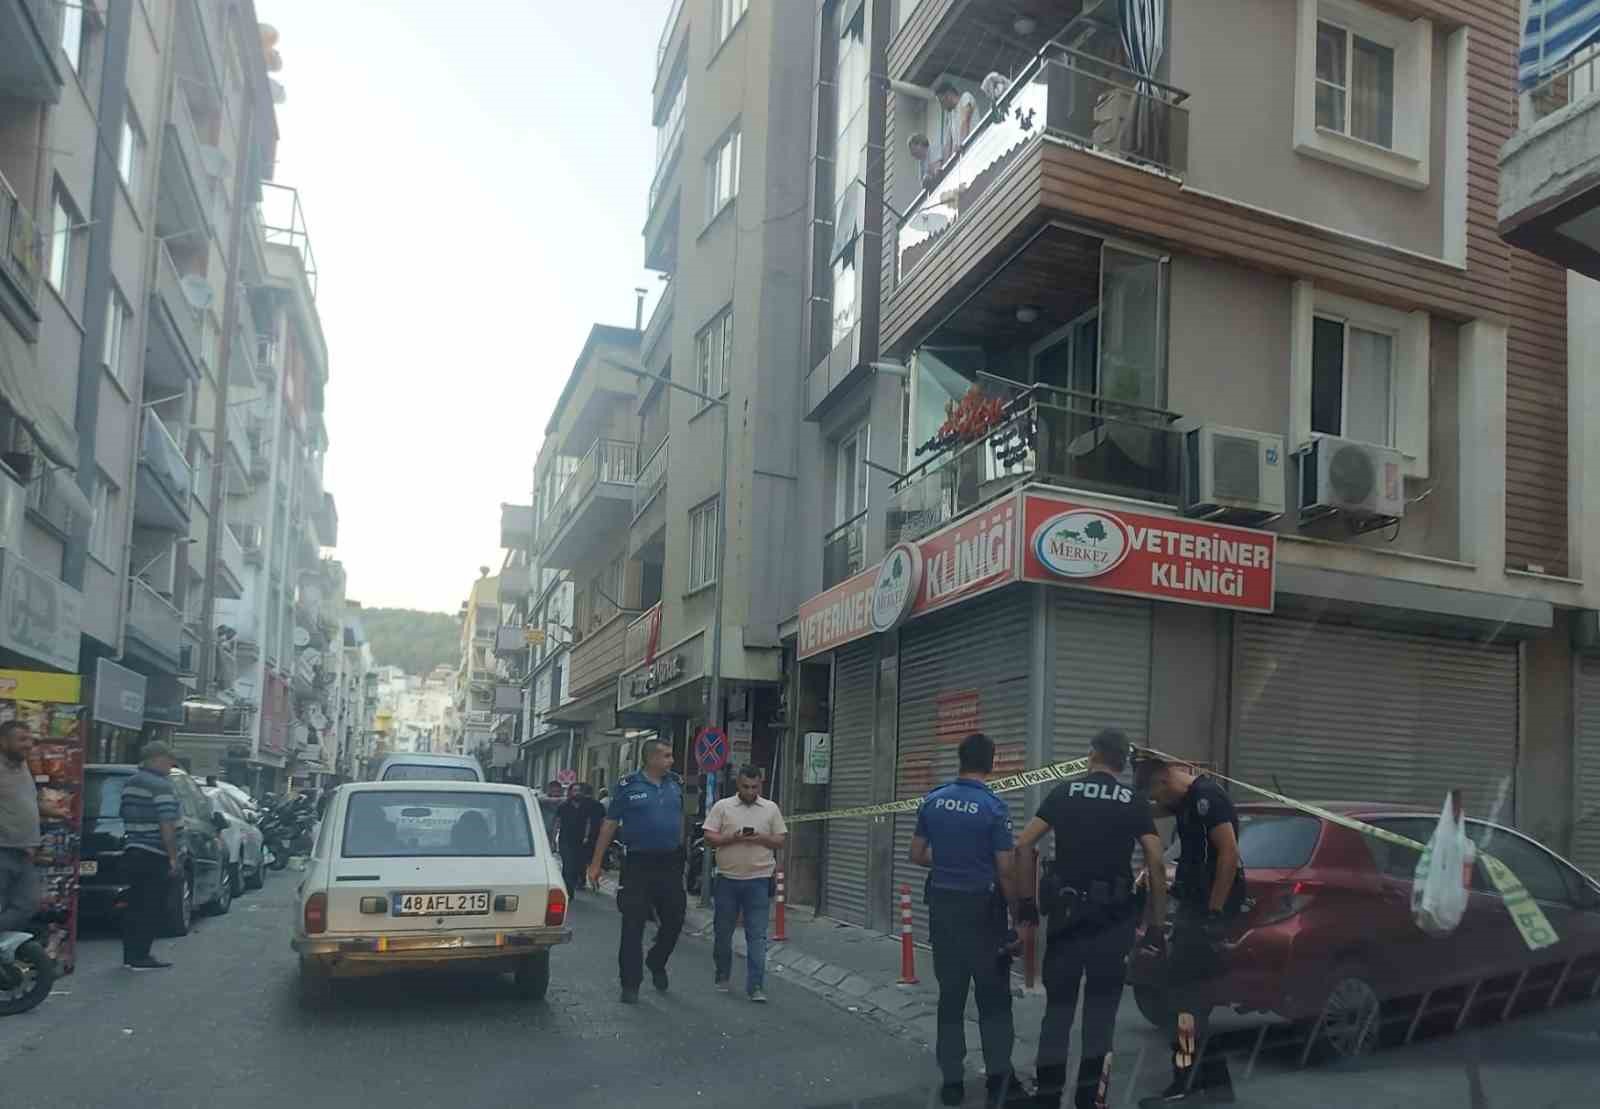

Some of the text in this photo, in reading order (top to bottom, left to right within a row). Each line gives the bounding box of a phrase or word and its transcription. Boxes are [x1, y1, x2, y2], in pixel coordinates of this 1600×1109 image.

[926, 508, 1013, 600] KLİNİĞİ
[1048, 541, 1108, 563] MERKEZ
[1127, 525, 1270, 570] VETERİNER
[1151, 560, 1244, 598] KLİNİĞİ
[404, 895, 486, 910] 48 AFL 215
